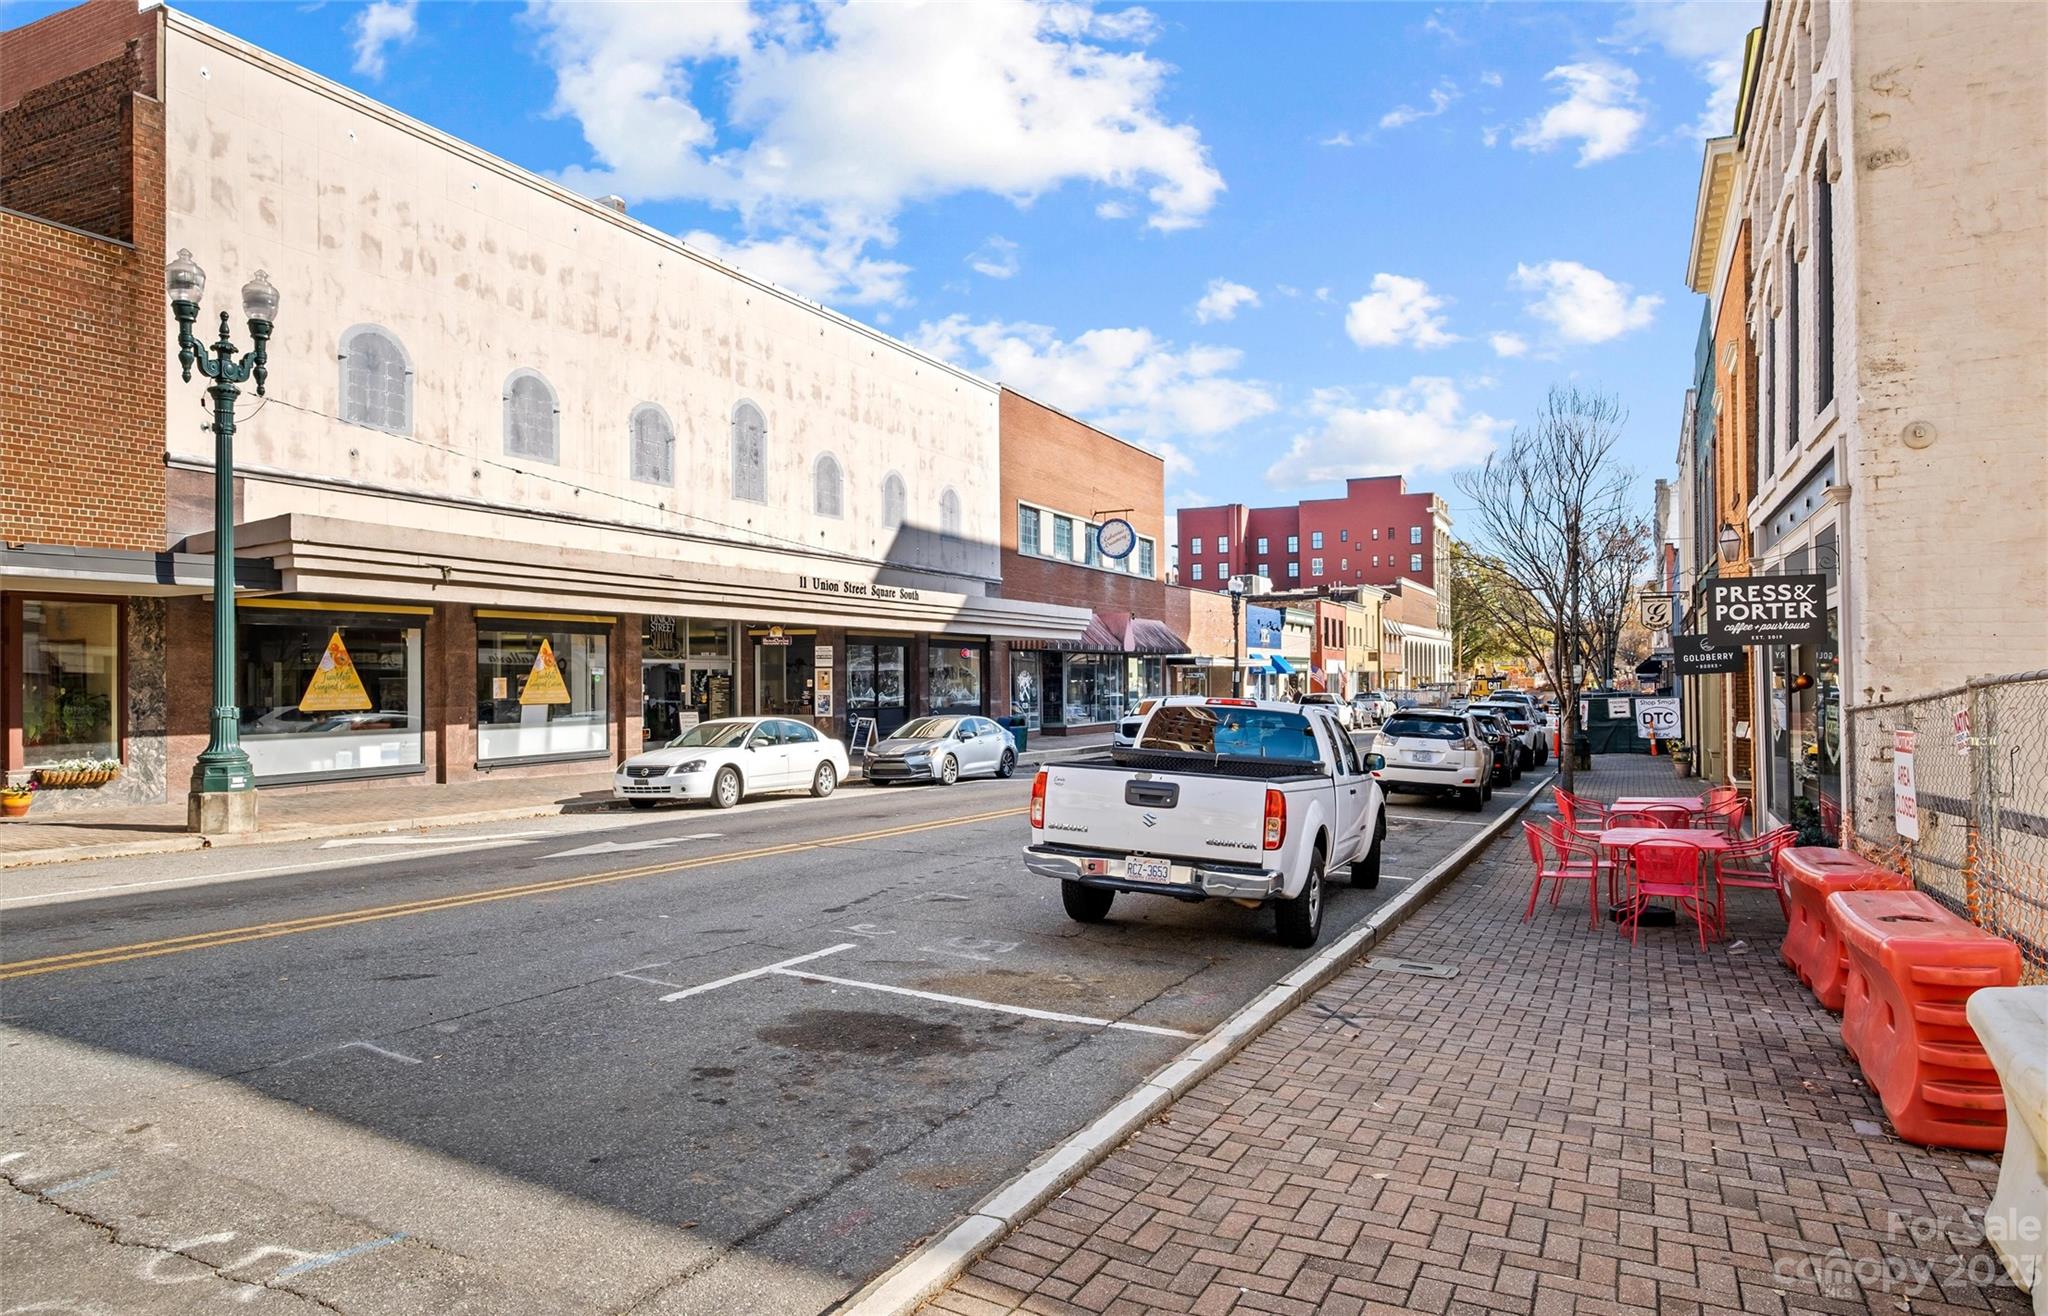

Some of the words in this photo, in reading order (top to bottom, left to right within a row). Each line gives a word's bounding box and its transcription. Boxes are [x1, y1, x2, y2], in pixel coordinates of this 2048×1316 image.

[799, 576, 807, 588] 11
[812, 577, 839, 592] Union
[843, 581, 867, 595] Street
[871, 584, 896, 599] Square
[899, 588, 919, 600] South
[1715, 602, 1817, 621] PORTER
[650, 615, 676, 624] UNION
[650, 623, 675, 632] STREET
[1723, 622, 1754, 635] coffee
[1758, 621, 1810, 633] pourhouse
[1683, 652, 1734, 663] GOLDBERRY
[1488, 681, 1501, 690] CAT
[1642, 712, 1674, 725] DTC
[1047, 823, 1089, 833] SUZUKI
[1205, 838, 1258, 850] EQUATOR
[1127, 862, 1168, 878] RCZ-3653
